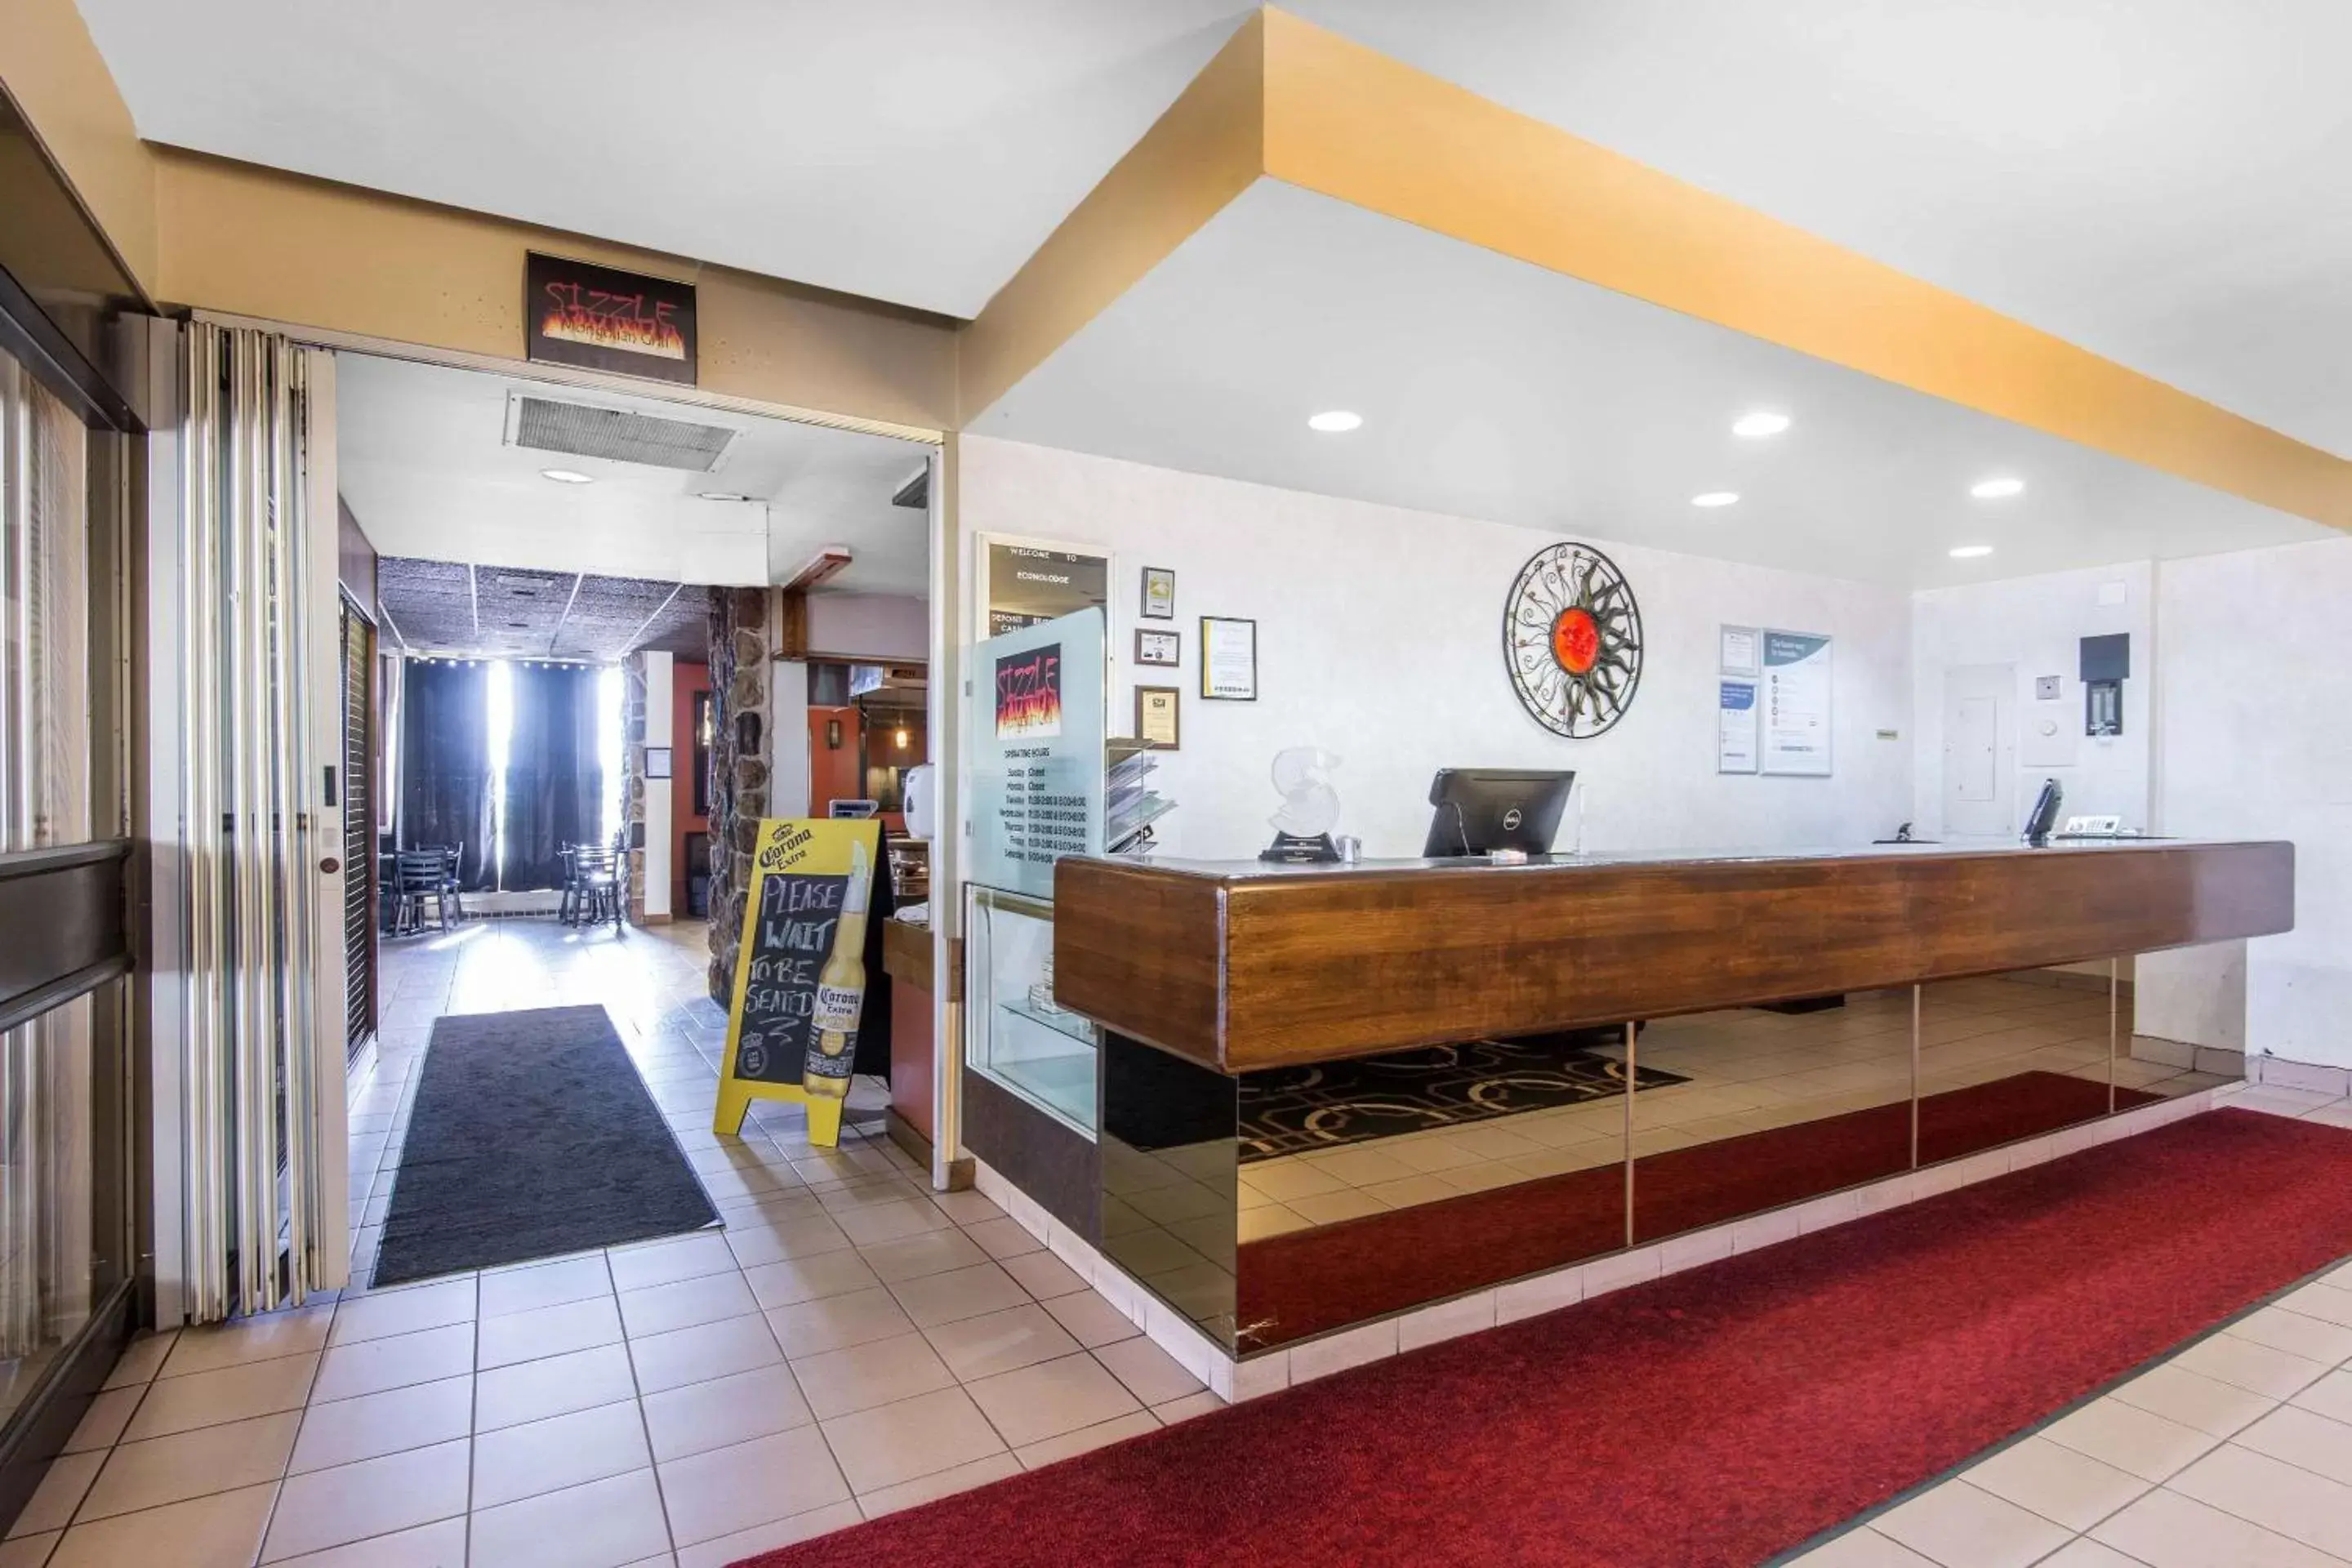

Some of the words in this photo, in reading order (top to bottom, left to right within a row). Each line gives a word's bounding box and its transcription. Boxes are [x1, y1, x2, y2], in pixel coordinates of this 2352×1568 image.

[1009, 547, 1050, 559] WELCOME
[1067, 555, 1077, 563] TO
[759, 828, 814, 868] Corona
[777, 849, 808, 871] Extra
[762, 875, 840, 916] PLEASE
[764, 917, 838, 952] WAIT
[750, 954, 771, 981] TO
[773, 957, 816, 986] BE
[745, 983, 816, 1017] SEATED
[820, 987, 860, 1007] Corona
